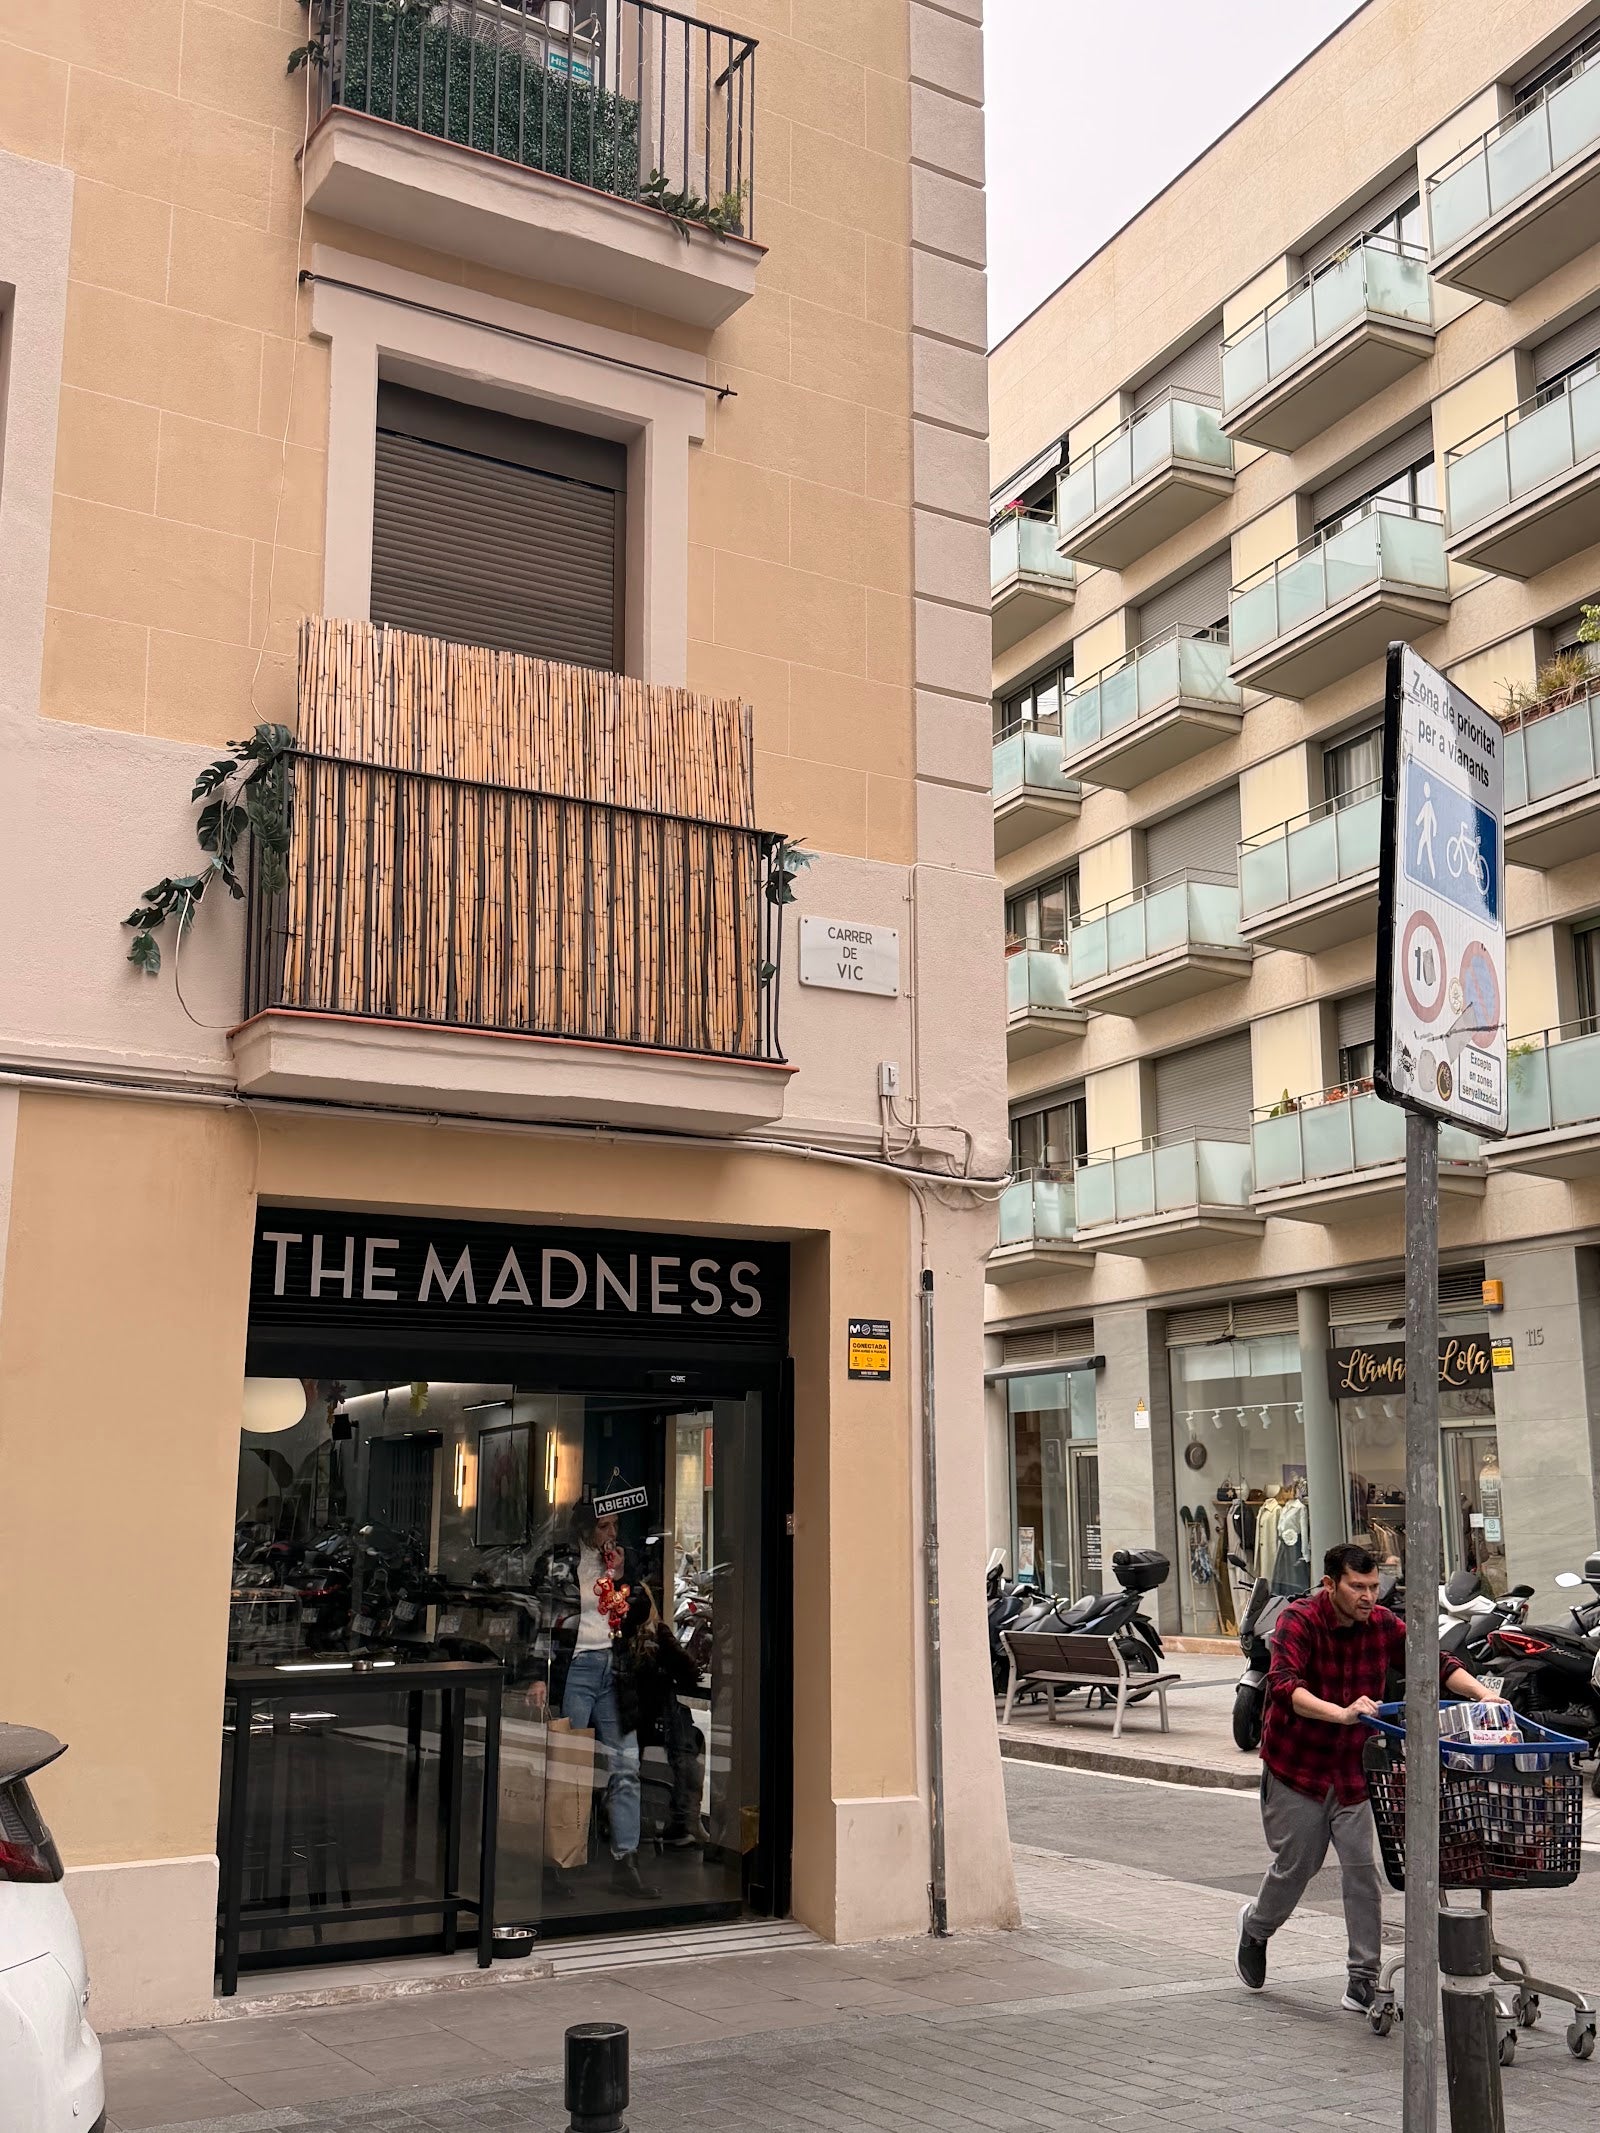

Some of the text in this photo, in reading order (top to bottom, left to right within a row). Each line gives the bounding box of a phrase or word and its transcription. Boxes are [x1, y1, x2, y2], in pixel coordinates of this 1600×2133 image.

[550, 56, 590, 77] Hisnse
[1412, 670, 1495, 758] Zona de prioritat
[1418, 718, 1489, 787] per a vianants
[827, 926, 873, 945] CARRER
[842, 946, 858, 960] DE
[836, 962, 863, 981] VIC
[262, 1231, 762, 1318] THE MADNESS
[852, 1342, 887, 1350] CONECTADA
[1525, 1328, 1545, 1347] 115
[1338, 1339, 1490, 1392] Lláma Lola
[598, 1492, 645, 1514] ABIERTO
